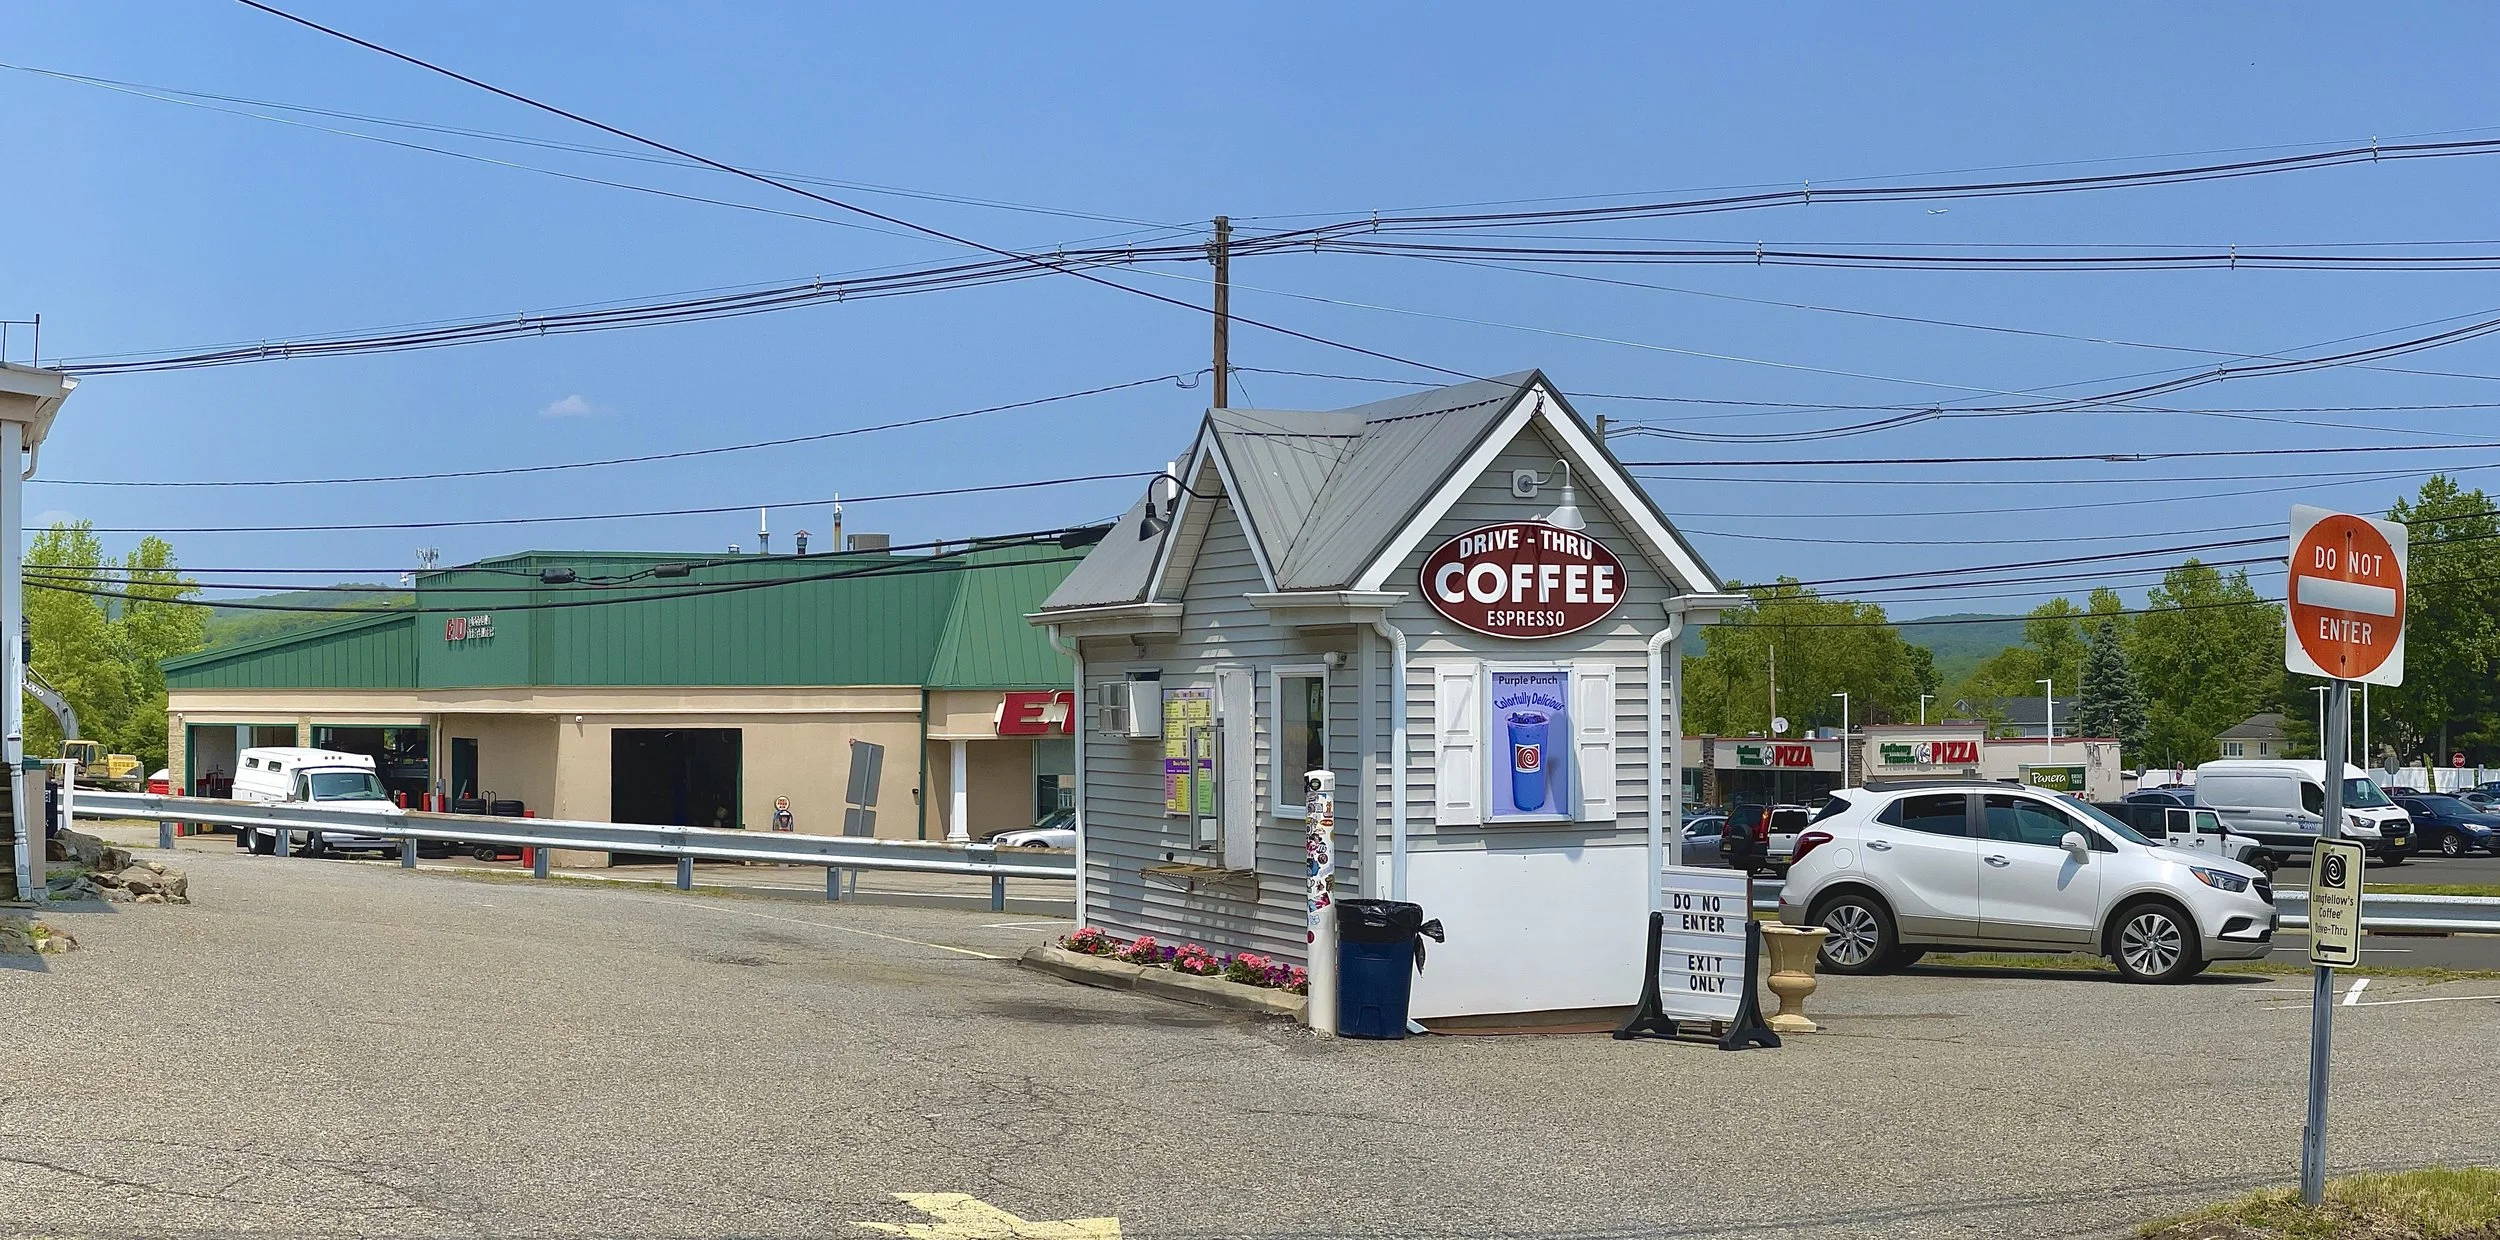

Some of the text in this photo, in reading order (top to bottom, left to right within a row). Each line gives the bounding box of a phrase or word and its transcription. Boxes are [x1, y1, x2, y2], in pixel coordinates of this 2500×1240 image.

[1459, 528, 1519, 559] DRIVE
[1540, 529, 1594, 561] THRU
[2315, 545, 2383, 578] DO NOT
[1435, 562, 1615, 604] COFFEE
[1487, 610, 1565, 627] ESPRESSO
[2319, 616, 2373, 646] ENTER
[1498, 675, 1558, 687] Purple Punch
[1494, 691, 1565, 711] Colorfully Delicious
[1775, 745, 1814, 768] PIZZA
[1879, 741, 1980, 764] Anthony PIZZA
[2031, 772, 2066, 784] Panera
[1673, 893, 1721, 913] DO NO
[2312, 891, 2354, 907] Longfellow's
[1682, 914, 1725, 933] ENTER
[2315, 922, 2348, 937] Drive-Thru
[1688, 954, 1722, 973] EXIT
[1689, 974, 1725, 994] ONLY
